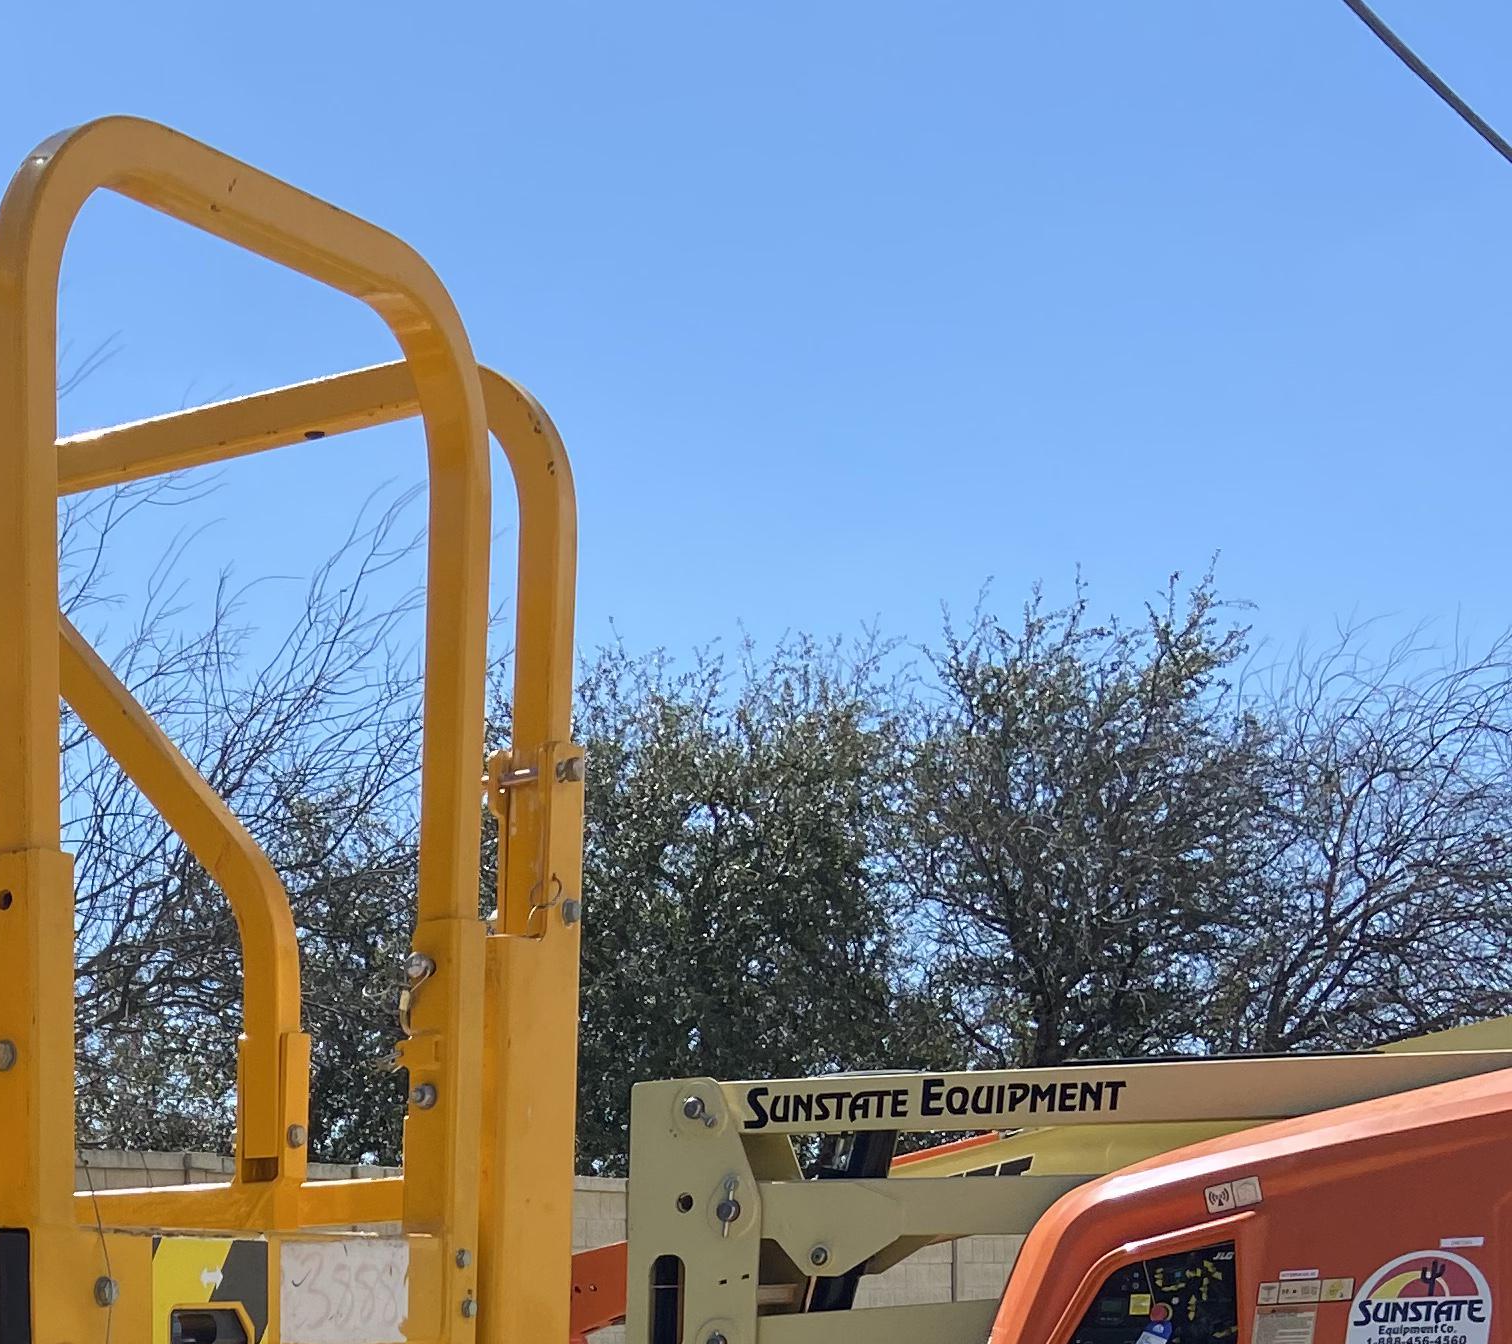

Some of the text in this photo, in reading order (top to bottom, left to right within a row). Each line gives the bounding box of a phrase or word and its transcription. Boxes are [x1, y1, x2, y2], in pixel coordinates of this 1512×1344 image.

[743, 1078, 1127, 1130] SUNSTATE EQUIPMENT
[1212, 1251, 1234, 1261] JLG
[1353, 1299, 1486, 1327] SUNSTATE
[1378, 1323, 1457, 1336] Equipment Co.
